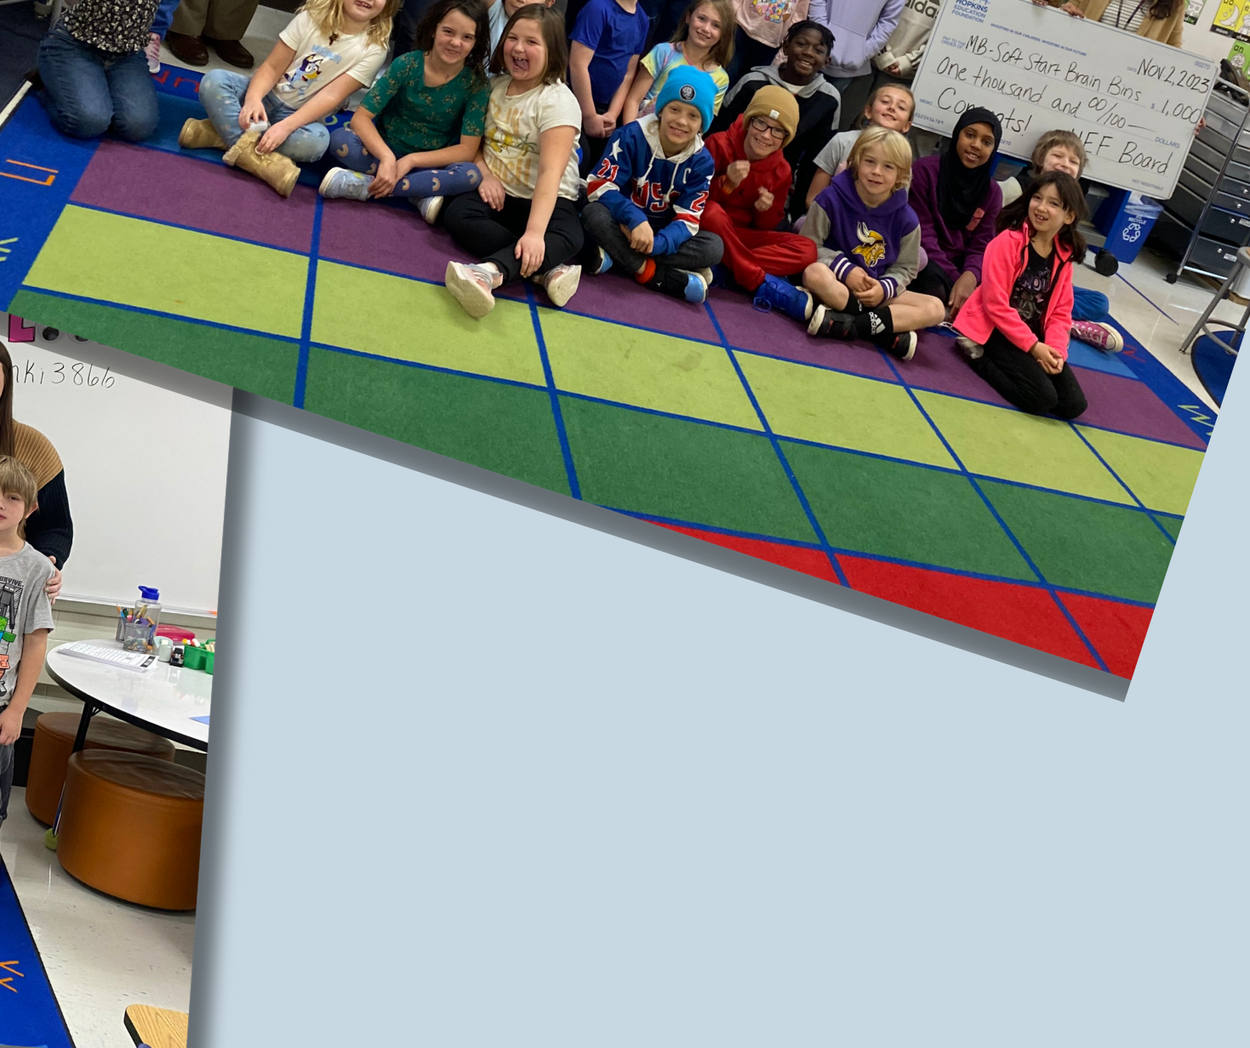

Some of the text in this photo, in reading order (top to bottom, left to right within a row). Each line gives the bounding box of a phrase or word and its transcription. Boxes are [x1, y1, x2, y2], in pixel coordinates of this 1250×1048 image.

[951, 10, 984, 23] FOUNDATION
[953, 4, 987, 19] EDUCATION
[972, 64, 1081, 119] thousand and
[1024, 53, 1061, 77] Start
[1064, 61, 1101, 91] Brain
[1108, 76, 1142, 102] Bins
[1118, 140, 1174, 175] Board
